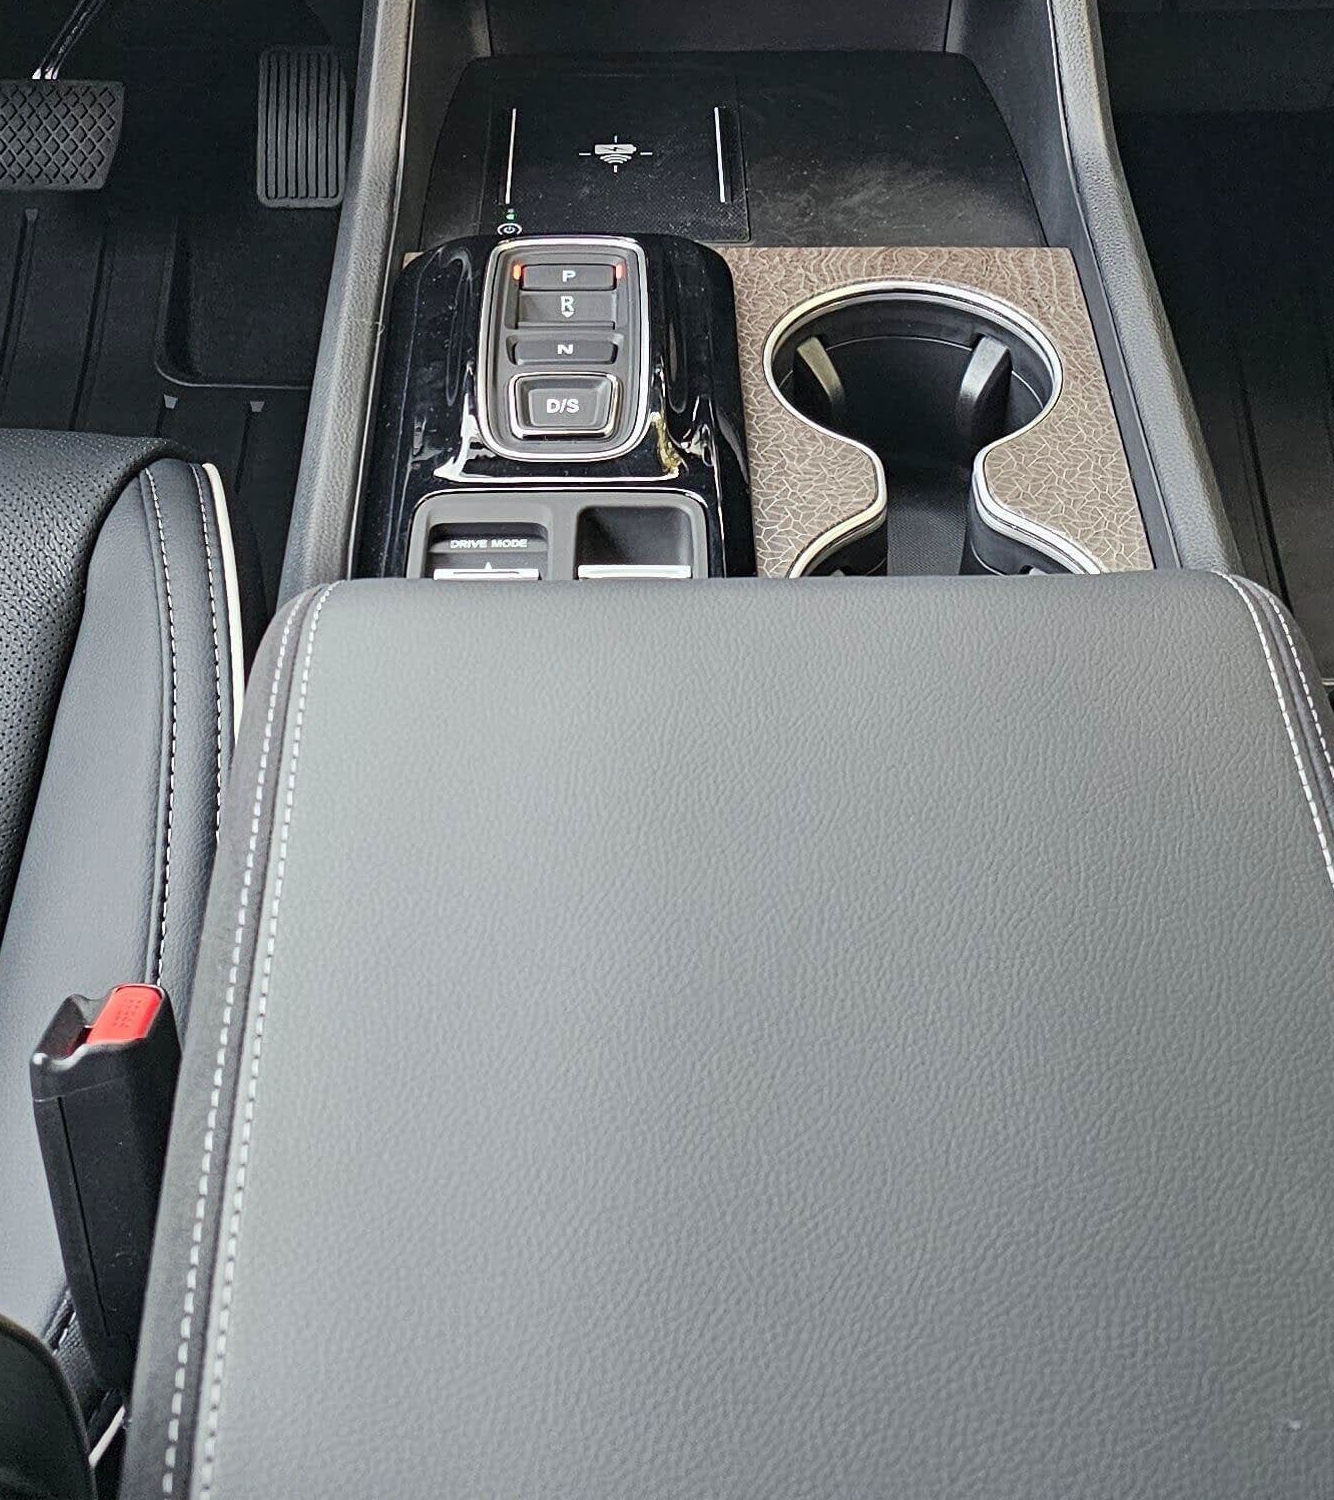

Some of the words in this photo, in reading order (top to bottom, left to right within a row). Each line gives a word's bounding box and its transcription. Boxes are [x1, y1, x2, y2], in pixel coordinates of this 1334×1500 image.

[562, 270, 575, 282] P
[560, 295, 574, 312] R
[557, 344, 574, 354] N
[546, 397, 579, 414] D/S
[450, 539, 488, 549] DRIVE
[491, 539, 528, 549] MODE
